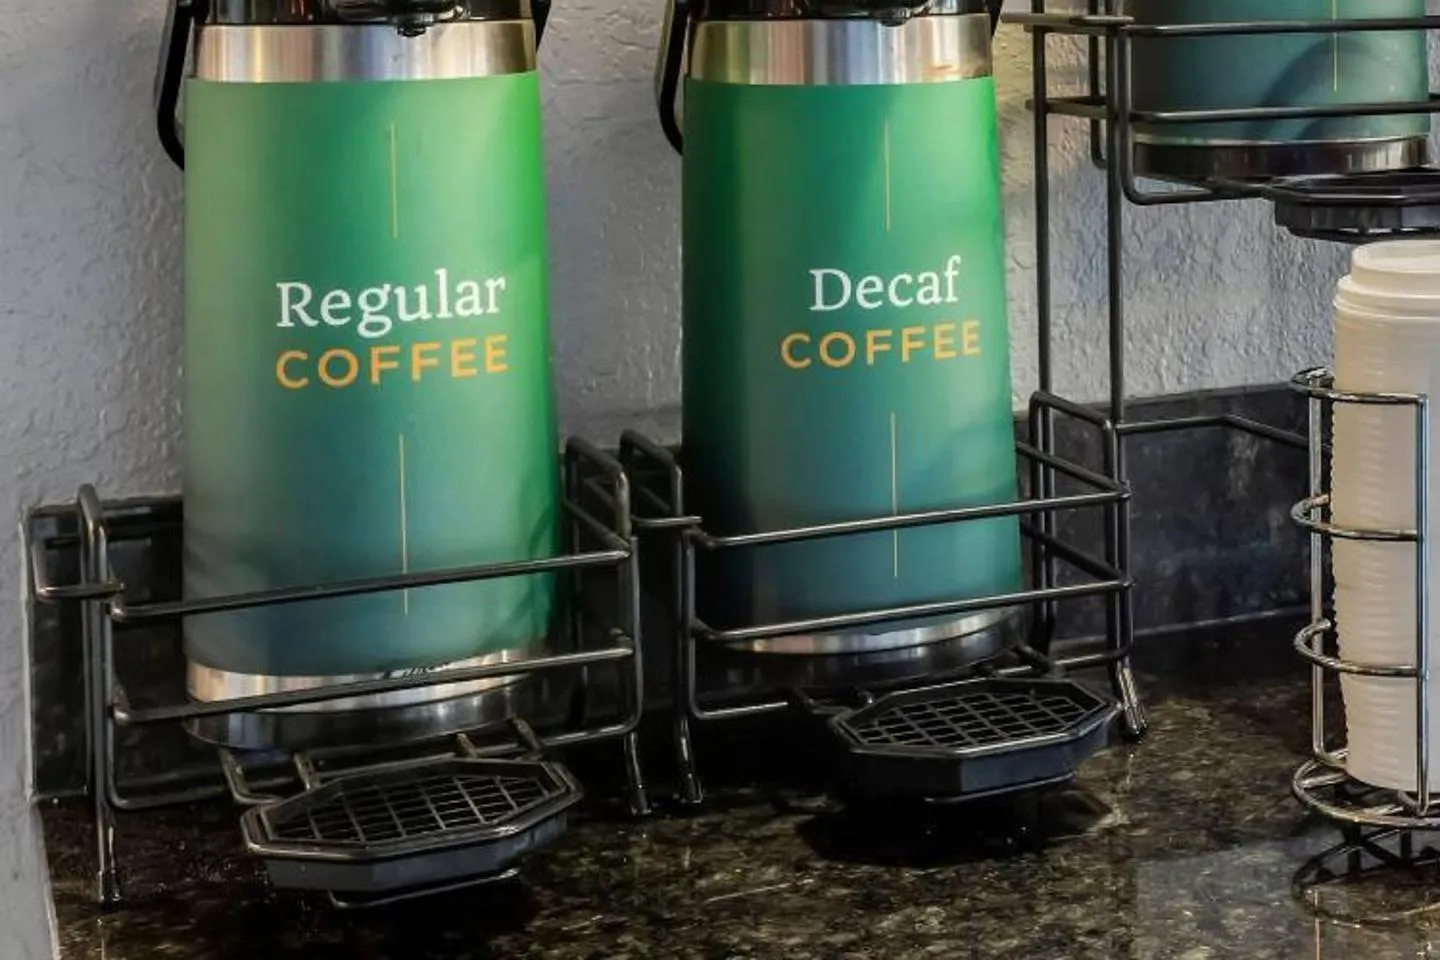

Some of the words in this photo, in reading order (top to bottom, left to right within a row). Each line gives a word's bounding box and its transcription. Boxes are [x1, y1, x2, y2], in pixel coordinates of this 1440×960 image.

[275, 268, 506, 339] Regular
[808, 254, 962, 312] Decaf
[275, 334, 508, 389] COFFEE
[779, 320, 982, 369] COFFEE
